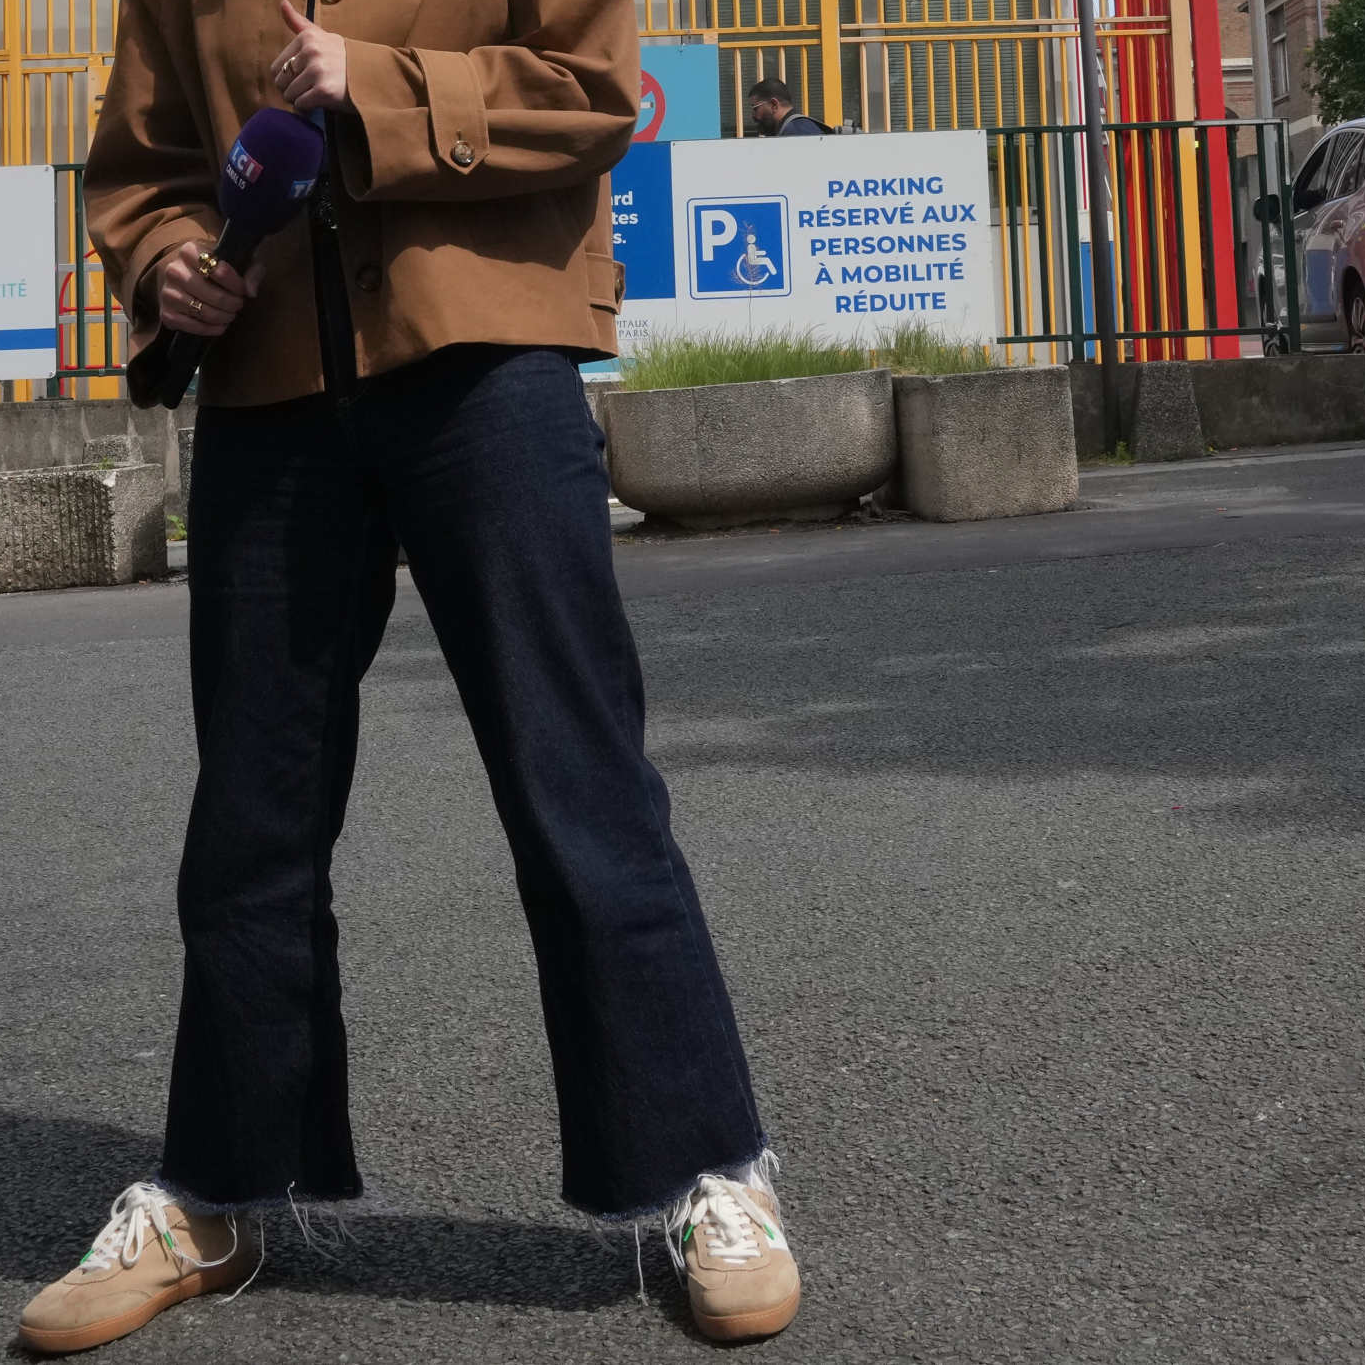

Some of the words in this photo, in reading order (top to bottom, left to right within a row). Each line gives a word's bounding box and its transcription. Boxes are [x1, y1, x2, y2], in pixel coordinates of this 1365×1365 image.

[828, 176, 944, 198] PARKING
[798, 201, 914, 228] RÉSERVÉ
[921, 203, 977, 224] AUX
[810, 233, 967, 256] PERSONNES
[814, 262, 834, 285] À
[841, 257, 965, 284] MOBILITÉ
[835, 290, 947, 314] RÉDUITE
